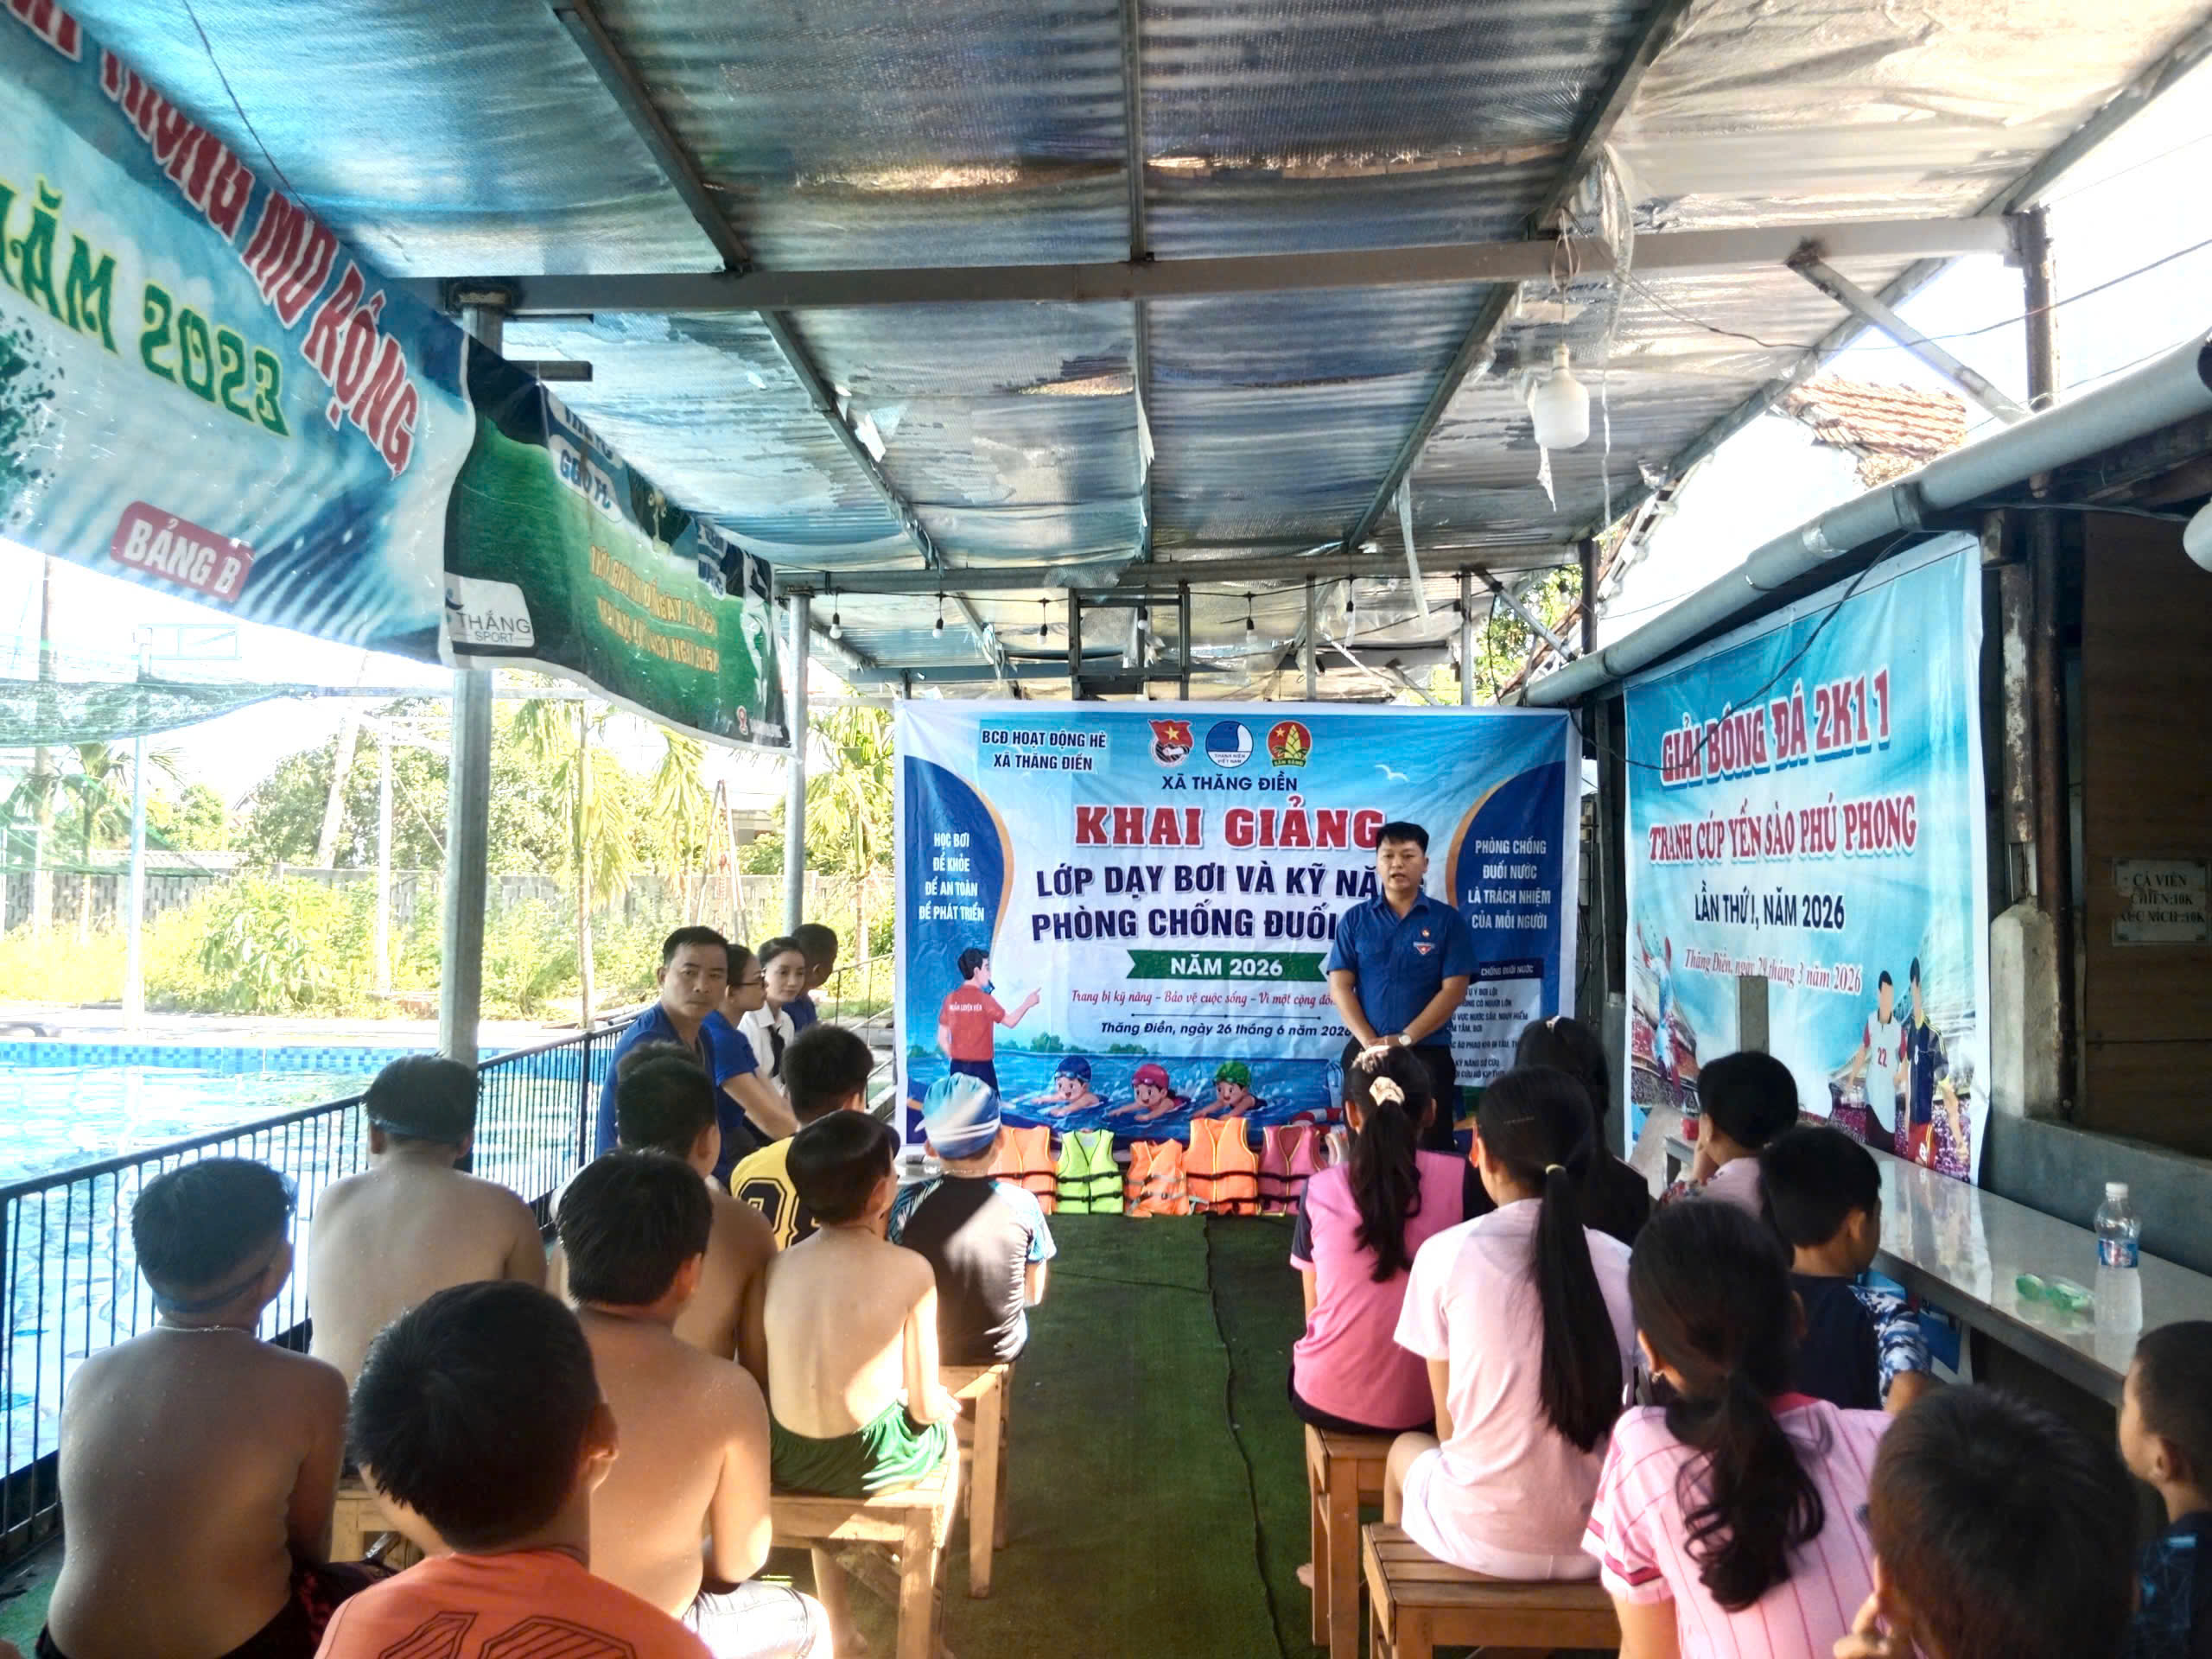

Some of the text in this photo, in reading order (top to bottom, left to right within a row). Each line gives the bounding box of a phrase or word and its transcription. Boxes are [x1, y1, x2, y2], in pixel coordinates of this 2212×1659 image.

[140, 282, 289, 437] 2023
[300, 259, 420, 481] RỘNG
[124, 518, 241, 594] BẢNG B
[456, 610, 531, 633] THẮNG
[474, 631, 513, 643] SPORT
[982, 730, 1106, 749] BCĐ HOẠT ĐỘNG HÈ
[1662, 715, 1702, 784] GIẢI
[1706, 705, 1768, 775] BÓNG
[1771, 679, 1808, 762] ĐÁ
[994, 752, 1010, 767] XÃ
[1015, 753, 1058, 769] THĂNG
[1161, 771, 1298, 791] XÃ THĂNG ĐIỀN
[1074, 794, 1386, 850] KHAI GIẢNG
[1649, 792, 1916, 861] TRANH CÚP YẾN SÀO PHÚ PHONG
[933, 832, 970, 851] HỌC BƠI
[1475, 836, 1547, 855] PHÒNG CHỐNG
[932, 851, 946, 872] ĐỂ
[1483, 860, 1537, 880] ĐUỐI NƯỚC
[925, 875, 978, 897] ĐỂ AN TOÀN
[1036, 861, 1380, 901] LỚP DẠY BƠI VÀ KỸ NĂ
[1468, 886, 1551, 907] LÀ TRÁCH NHIỆM
[1694, 880, 1719, 922] LẦN
[1723, 886, 1750, 924] THỨ
[1764, 887, 1796, 926] NĂM
[1802, 894, 1845, 930] 2026
[918, 899, 984, 922] ĐỂ PHÁT TRIỂN
[1032, 899, 1338, 942] PHÒNG CHỐNG ĐUỐI
[1471, 909, 1492, 929] CỦA
[1517, 912, 1547, 930] NGƯỜI
[1170, 953, 1283, 976] NĂM 2026
[1685, 949, 1711, 976] Thăng
[1769, 958, 1795, 988] tháng
[1798, 962, 1803, 984] 3
[1807, 965, 1829, 988] năm
[1834, 966, 1861, 993] 2026
[1072, 989, 1099, 1005] Trang
[1102, 990, 1110, 1003] bị
[1114, 990, 1125, 1006] kỹ
[1128, 991, 1153, 1006] năng
[1164, 989, 1183, 1002] Bảo
[1186, 991, 1197, 1005] vệ
[1200, 991, 1223, 1005] cuộc
[1225, 991, 1248, 1007] sống
[1273, 994, 1290, 1006] một
[1294, 994, 1316, 1008] cộng
[1101, 1020, 1351, 1037] Thăng Điền, ngày 26 tháng 6 năm 2026
[1877, 1046, 1887, 1068] 22
